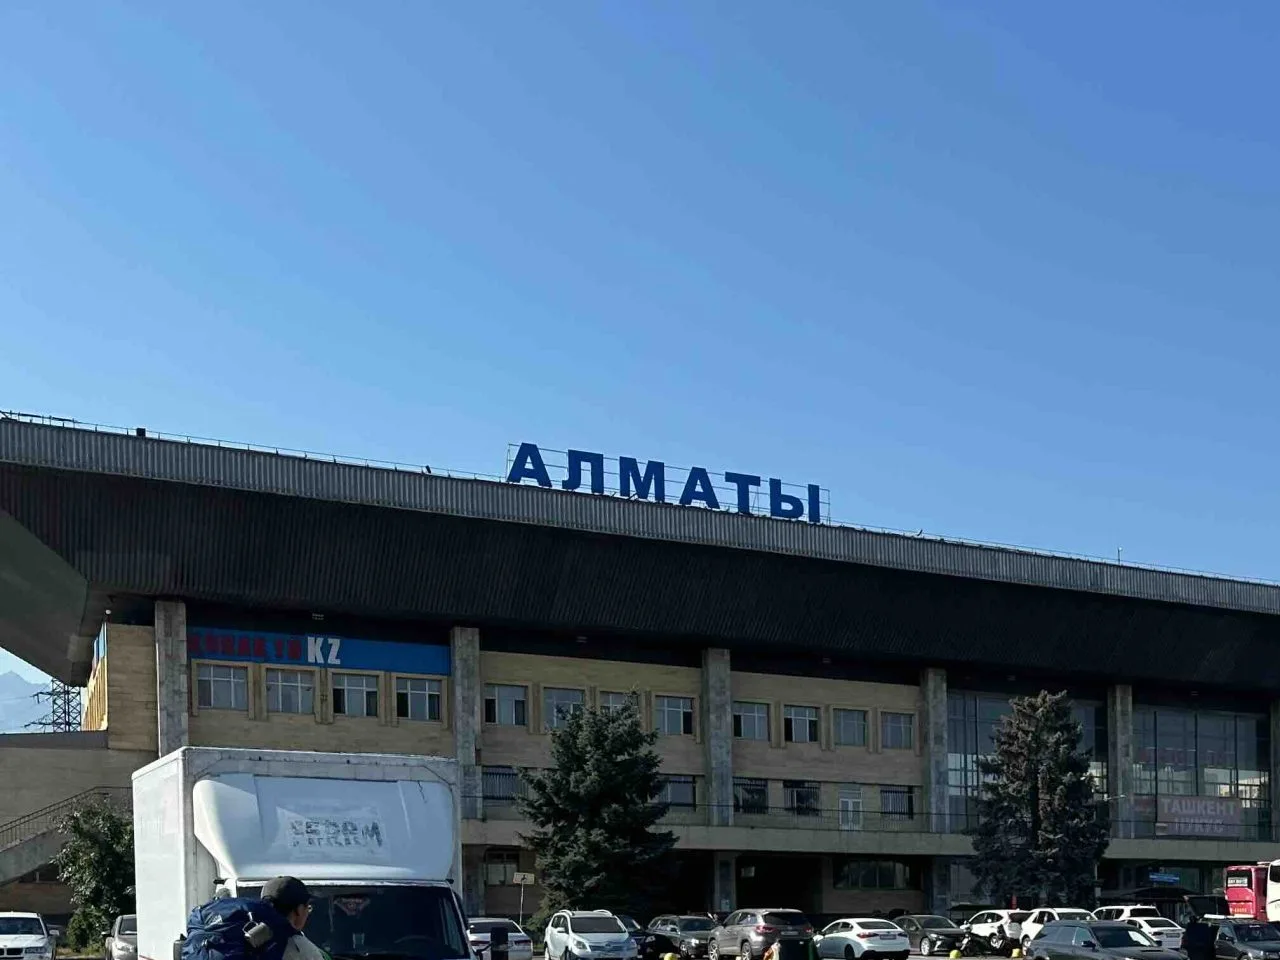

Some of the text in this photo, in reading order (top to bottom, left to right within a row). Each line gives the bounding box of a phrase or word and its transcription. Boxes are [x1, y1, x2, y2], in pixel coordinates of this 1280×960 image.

[506, 442, 821, 523] АЛМАТЫ
[307, 636, 341, 665] KZ
[1161, 797, 1236, 816] ТАШКЕНТ
